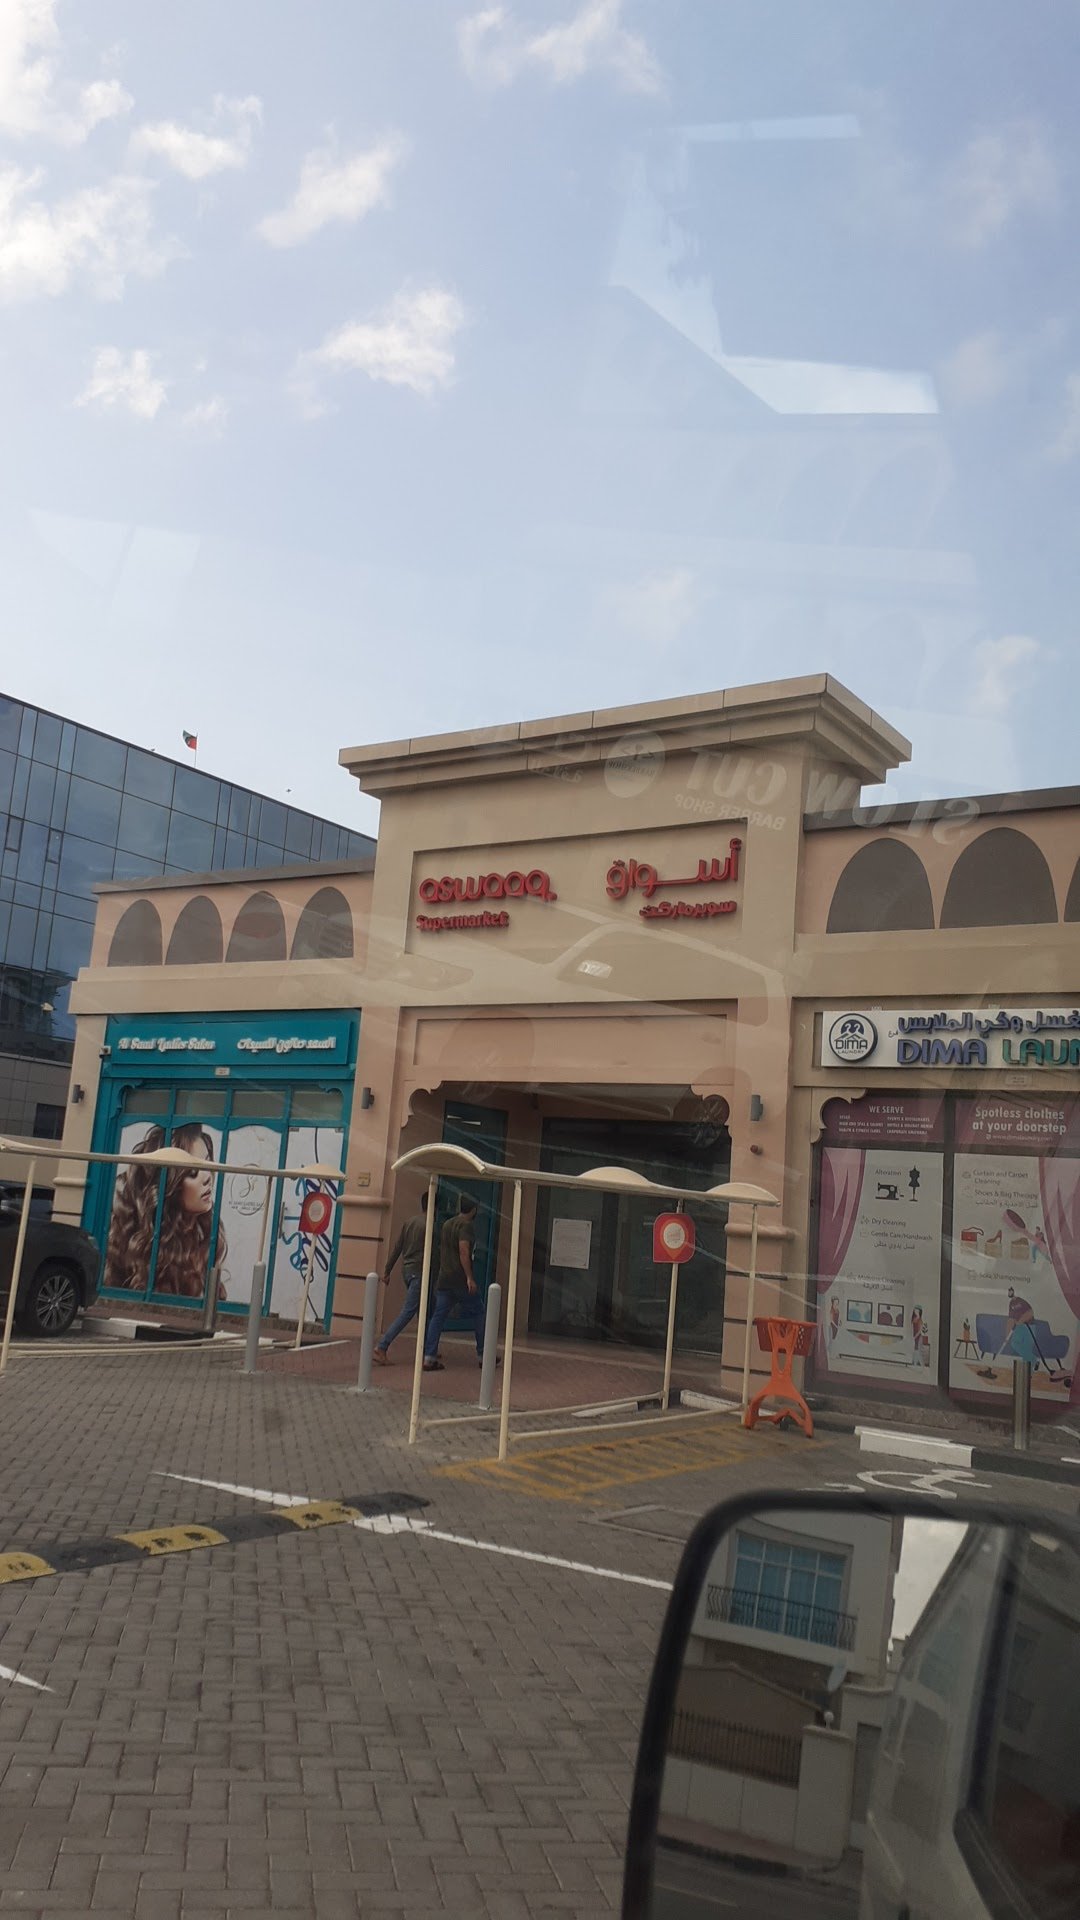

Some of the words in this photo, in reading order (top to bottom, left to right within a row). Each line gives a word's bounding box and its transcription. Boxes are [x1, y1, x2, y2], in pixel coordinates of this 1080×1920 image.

[606, 837, 743, 900] أسواق
[638, 899, 737, 922] سوبرماركت
[416, 910, 510, 933] Supermarket
[896, 1012, 974, 1035] الملابس
[974, 1011, 1024, 1039] وكي
[833, 1039, 868, 1051] DIMA
[896, 1037, 988, 1066] DIMA
[868, 1105, 881, 1114] WE
[881, 1106, 905, 1115] SERVE
[975, 1106, 1021, 1120] Spotless
[1024, 1107, 1065, 1120] clothes
[972, 1119, 984, 1131] at
[987, 1121, 1013, 1134] your
[1016, 1120, 1067, 1136] doorstep
[875, 1168, 902, 1177] Alteration
[973, 1169, 995, 1177] Curtain
[974, 1178, 1001, 1187] Cleaning
[871, 1217, 881, 1226] Dry
[882, 1218, 907, 1228] Cleaning
[870, 1230, 889, 1238] Gentle
